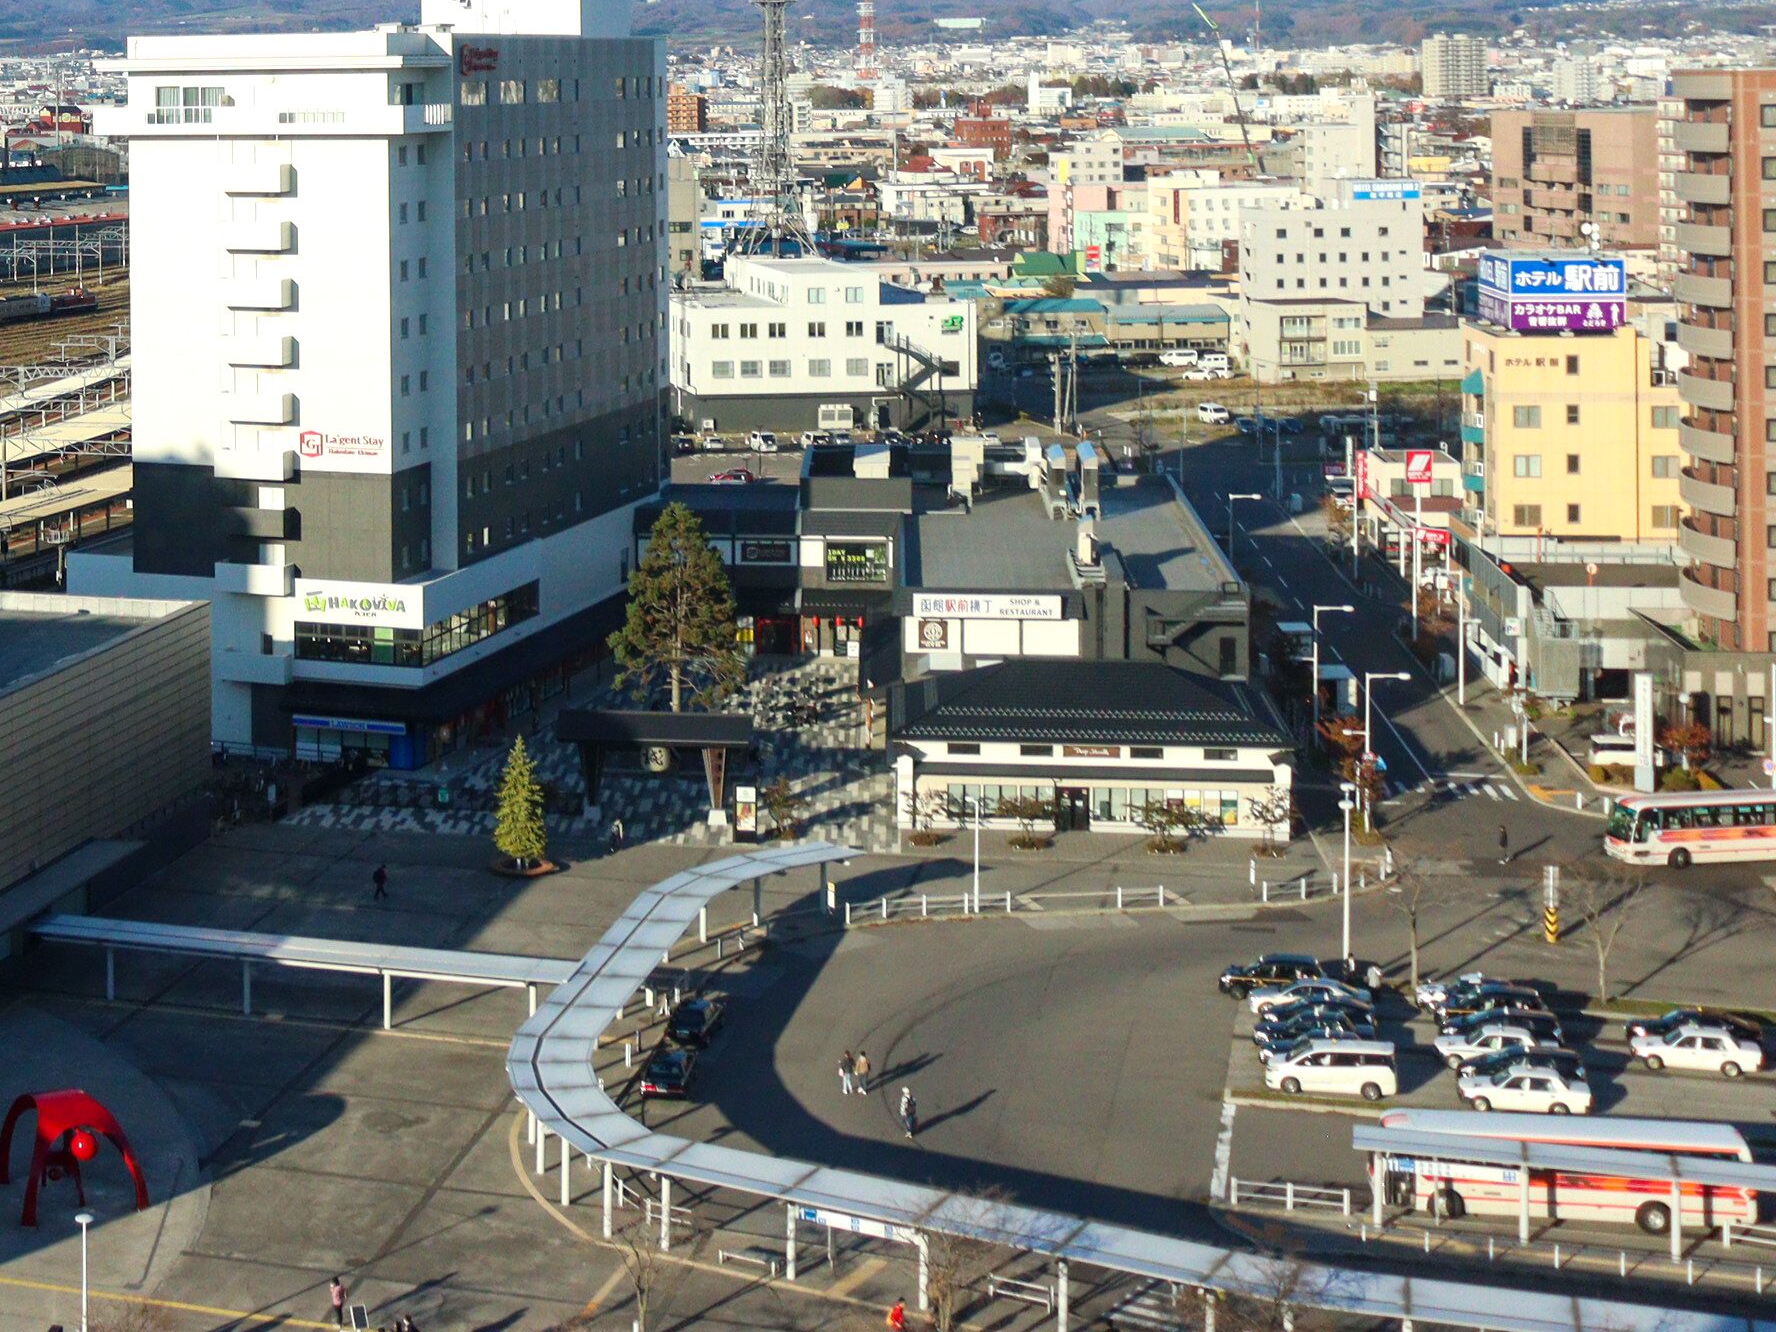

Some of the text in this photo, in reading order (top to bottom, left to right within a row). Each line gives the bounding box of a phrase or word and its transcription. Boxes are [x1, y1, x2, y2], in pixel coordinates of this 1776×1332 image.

[1515, 264, 1620, 291] ホテル 駅前
[1514, 304, 1581, 316] カラオケBAR
[363, 435, 384, 448] Stay
[1009, 598, 1032, 606] SHOP
[999, 608, 1053, 616] RESTAURANT
